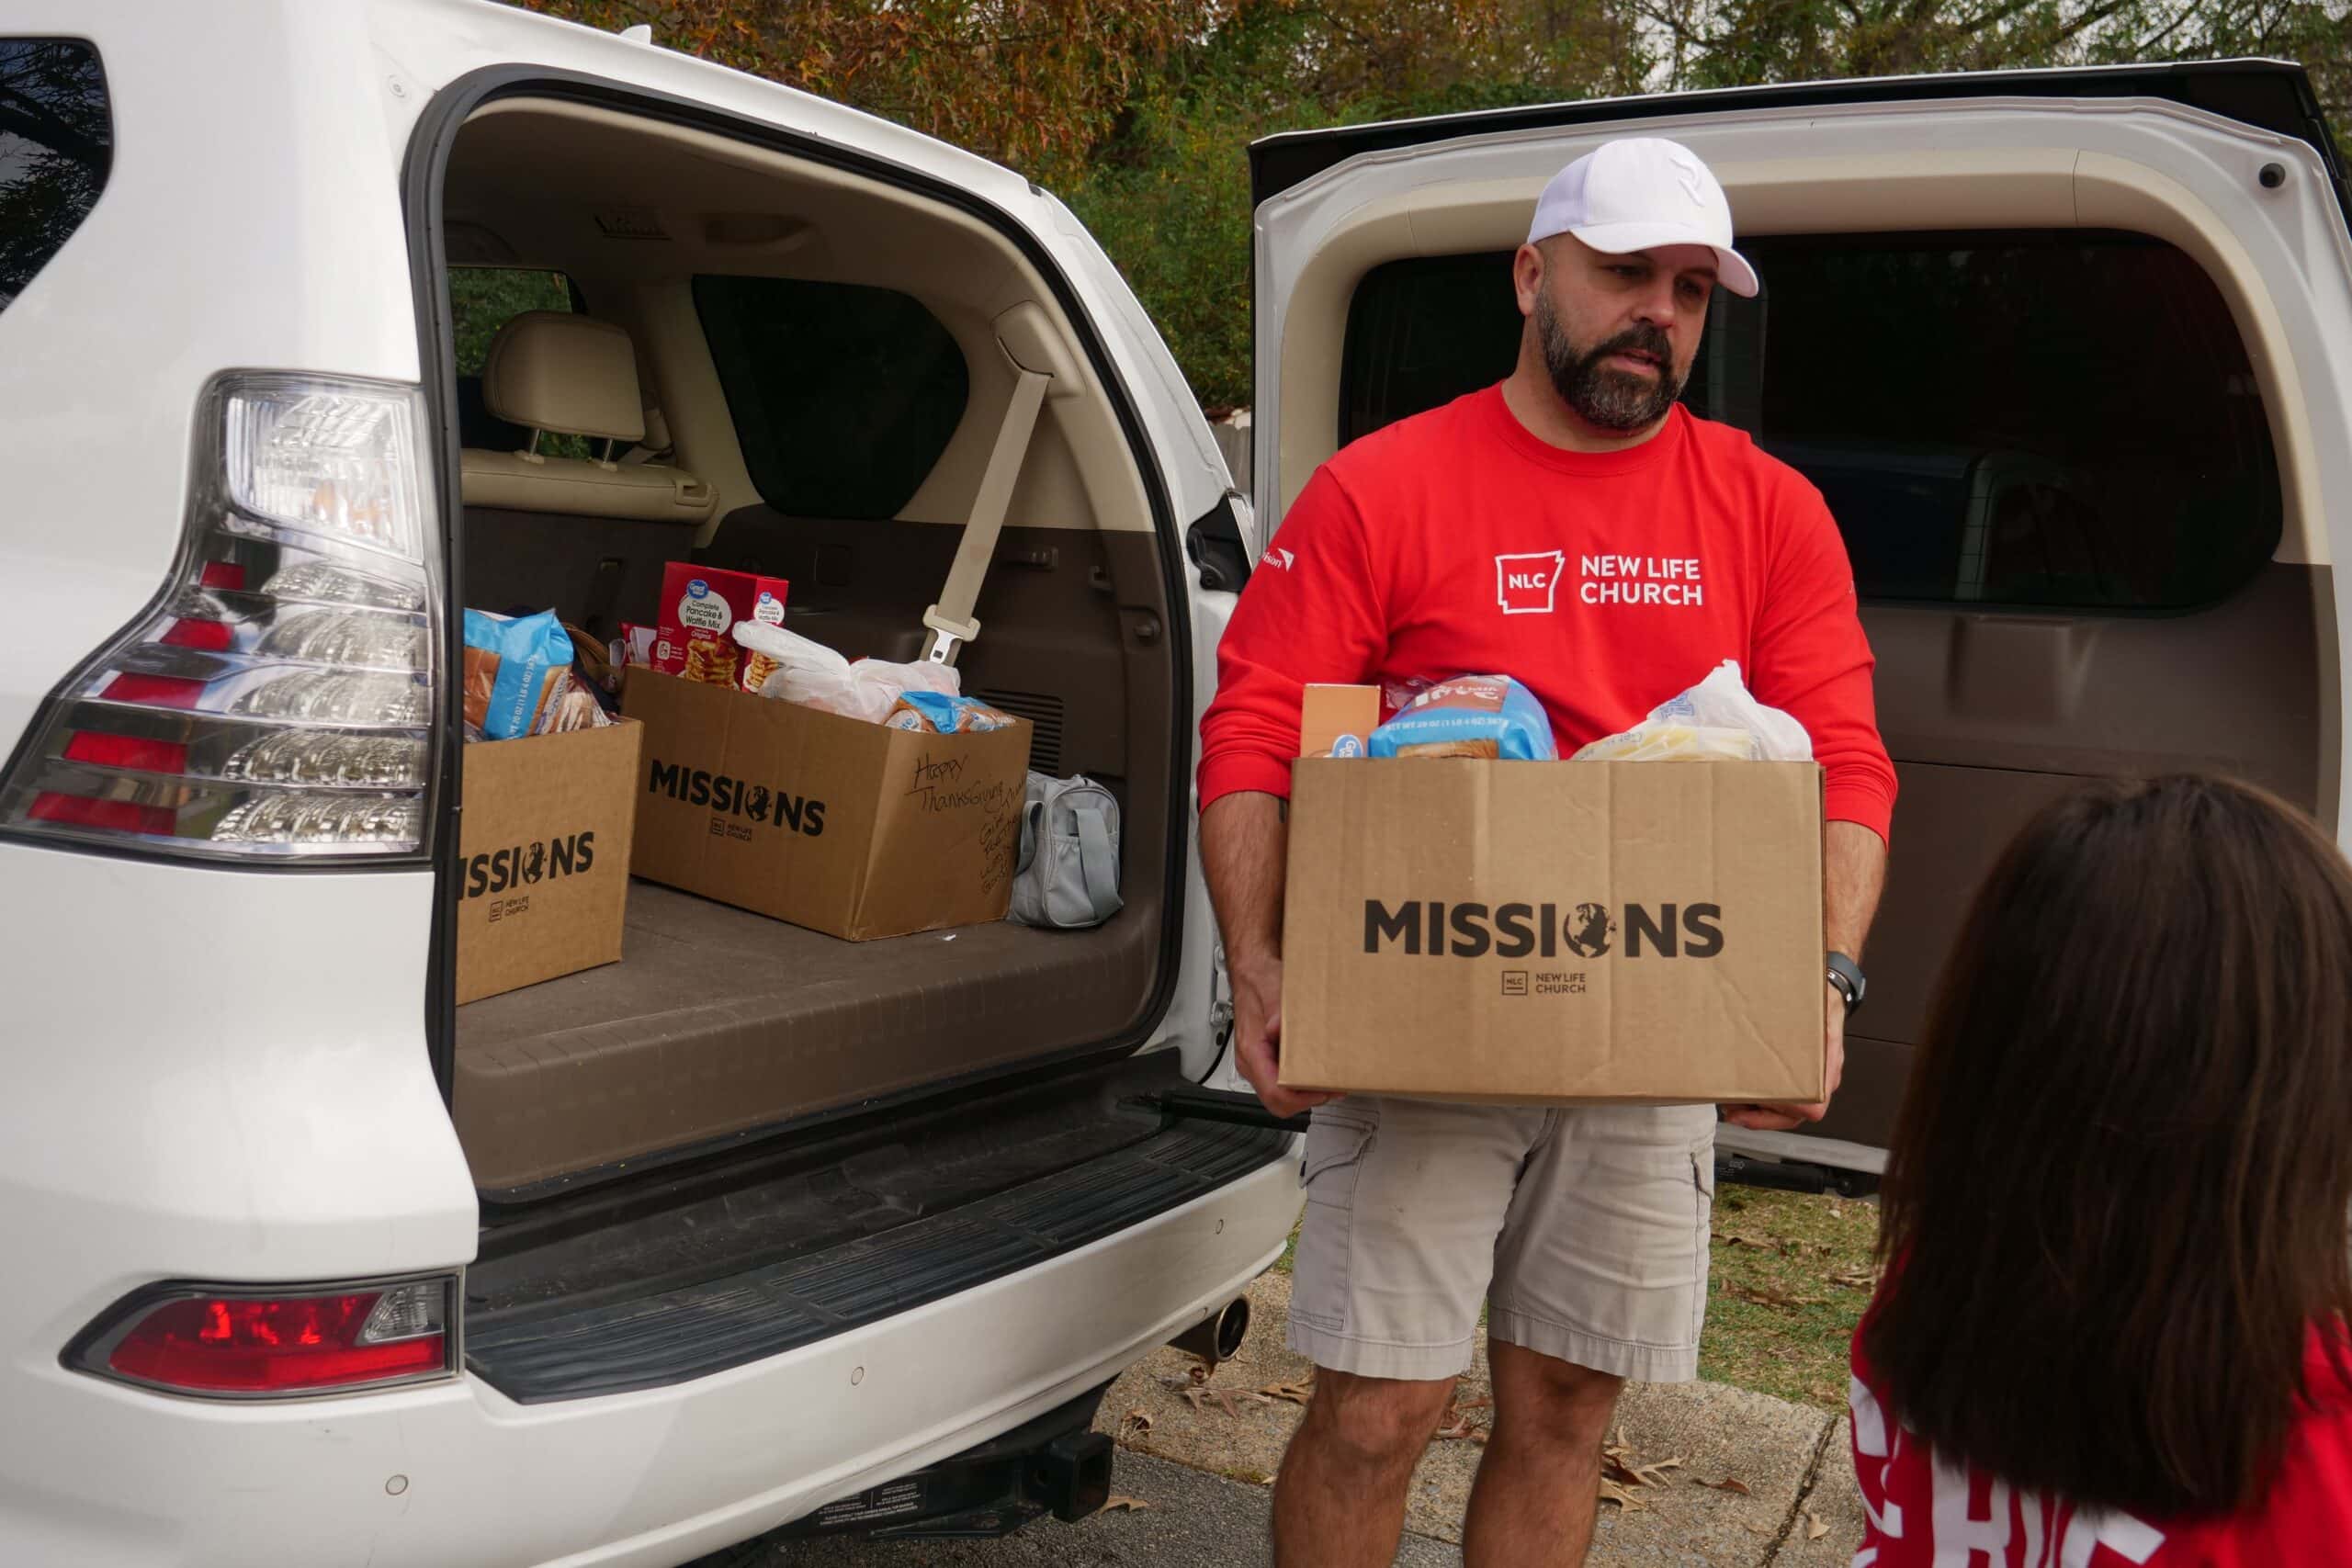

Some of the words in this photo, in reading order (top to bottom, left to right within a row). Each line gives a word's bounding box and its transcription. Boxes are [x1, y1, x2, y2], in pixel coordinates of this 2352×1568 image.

[1261, 551, 1282, 569] ison
[1581, 555, 1641, 577] NEW
[1647, 557, 1701, 580] LIFE
[1509, 572, 1546, 589] NLC
[1580, 582, 1702, 605] CHURCH
[686, 605, 717, 619] Pancake
[718, 611, 723, 620] &
[686, 615, 707, 626] Waffle
[707, 619, 721, 629] Mix
[914, 752, 968, 788] Happy
[649, 759, 826, 837] MISSIONS
[459, 831, 594, 900] ISSIONS
[1363, 899, 1724, 959] MISSIONS
[1507, 976, 1522, 985] NLC
[1536, 973, 1562, 982] NEW
[1564, 973, 1586, 982] LIFE
[1536, 984, 1586, 993] CHURCH
